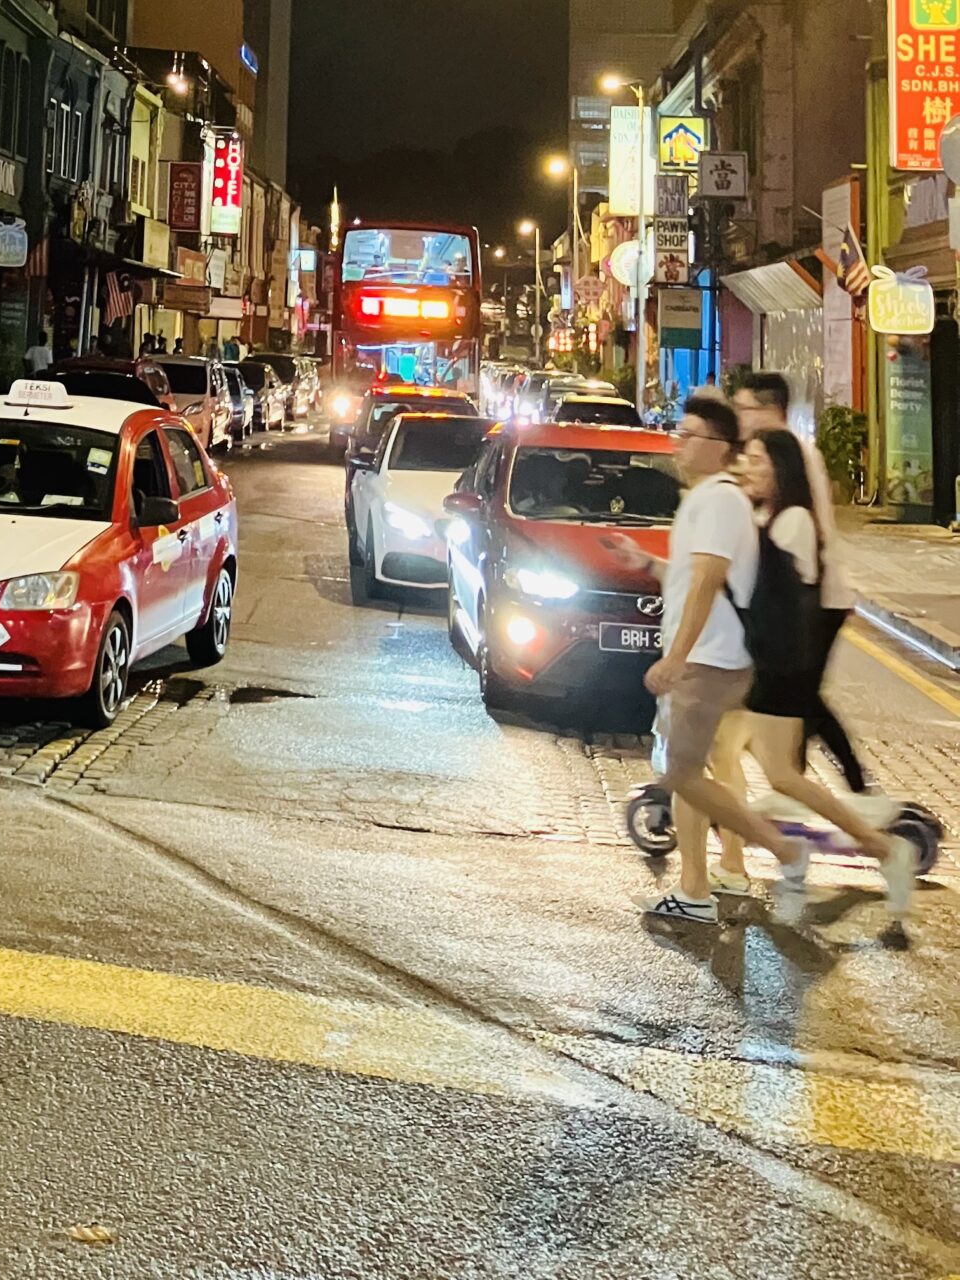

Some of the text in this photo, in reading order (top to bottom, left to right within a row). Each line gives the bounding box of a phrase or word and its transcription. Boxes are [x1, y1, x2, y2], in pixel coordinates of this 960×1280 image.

[896, 33, 957, 63] SHE
[656, 221, 688, 233] PAWN
[656, 234, 688, 248] SHOP
[24, 382, 52, 392] TEKSI
[621, 628, 650, 648] BRH
